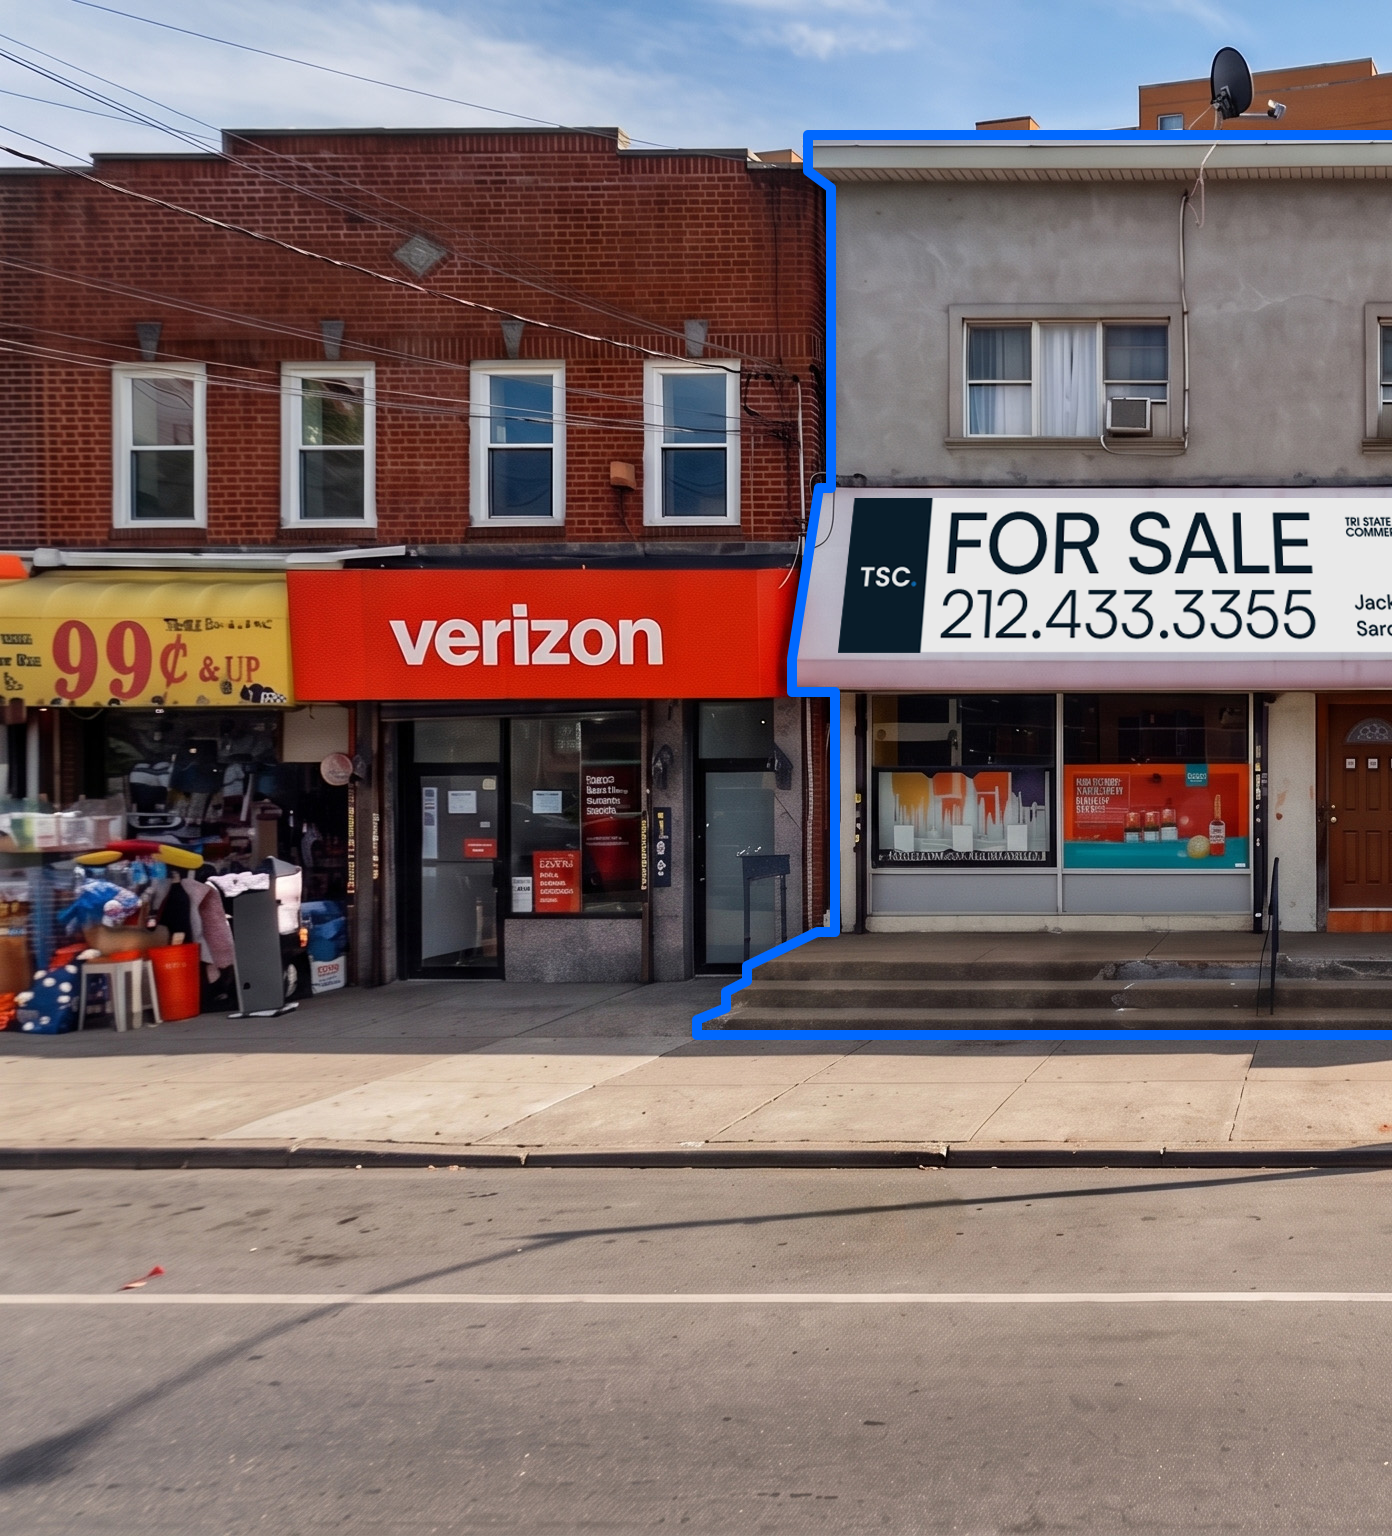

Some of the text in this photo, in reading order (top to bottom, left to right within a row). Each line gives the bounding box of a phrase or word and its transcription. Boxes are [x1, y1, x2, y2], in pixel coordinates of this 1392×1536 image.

[946, 511, 1315, 575] FOR SALE
[1345, 517, 1392, 526] TRI STATE
[389, 603, 664, 666] verizon
[940, 588, 1316, 640] 212.433.3355
[199, 655, 220, 683] &
[224, 655, 261, 683] UP
